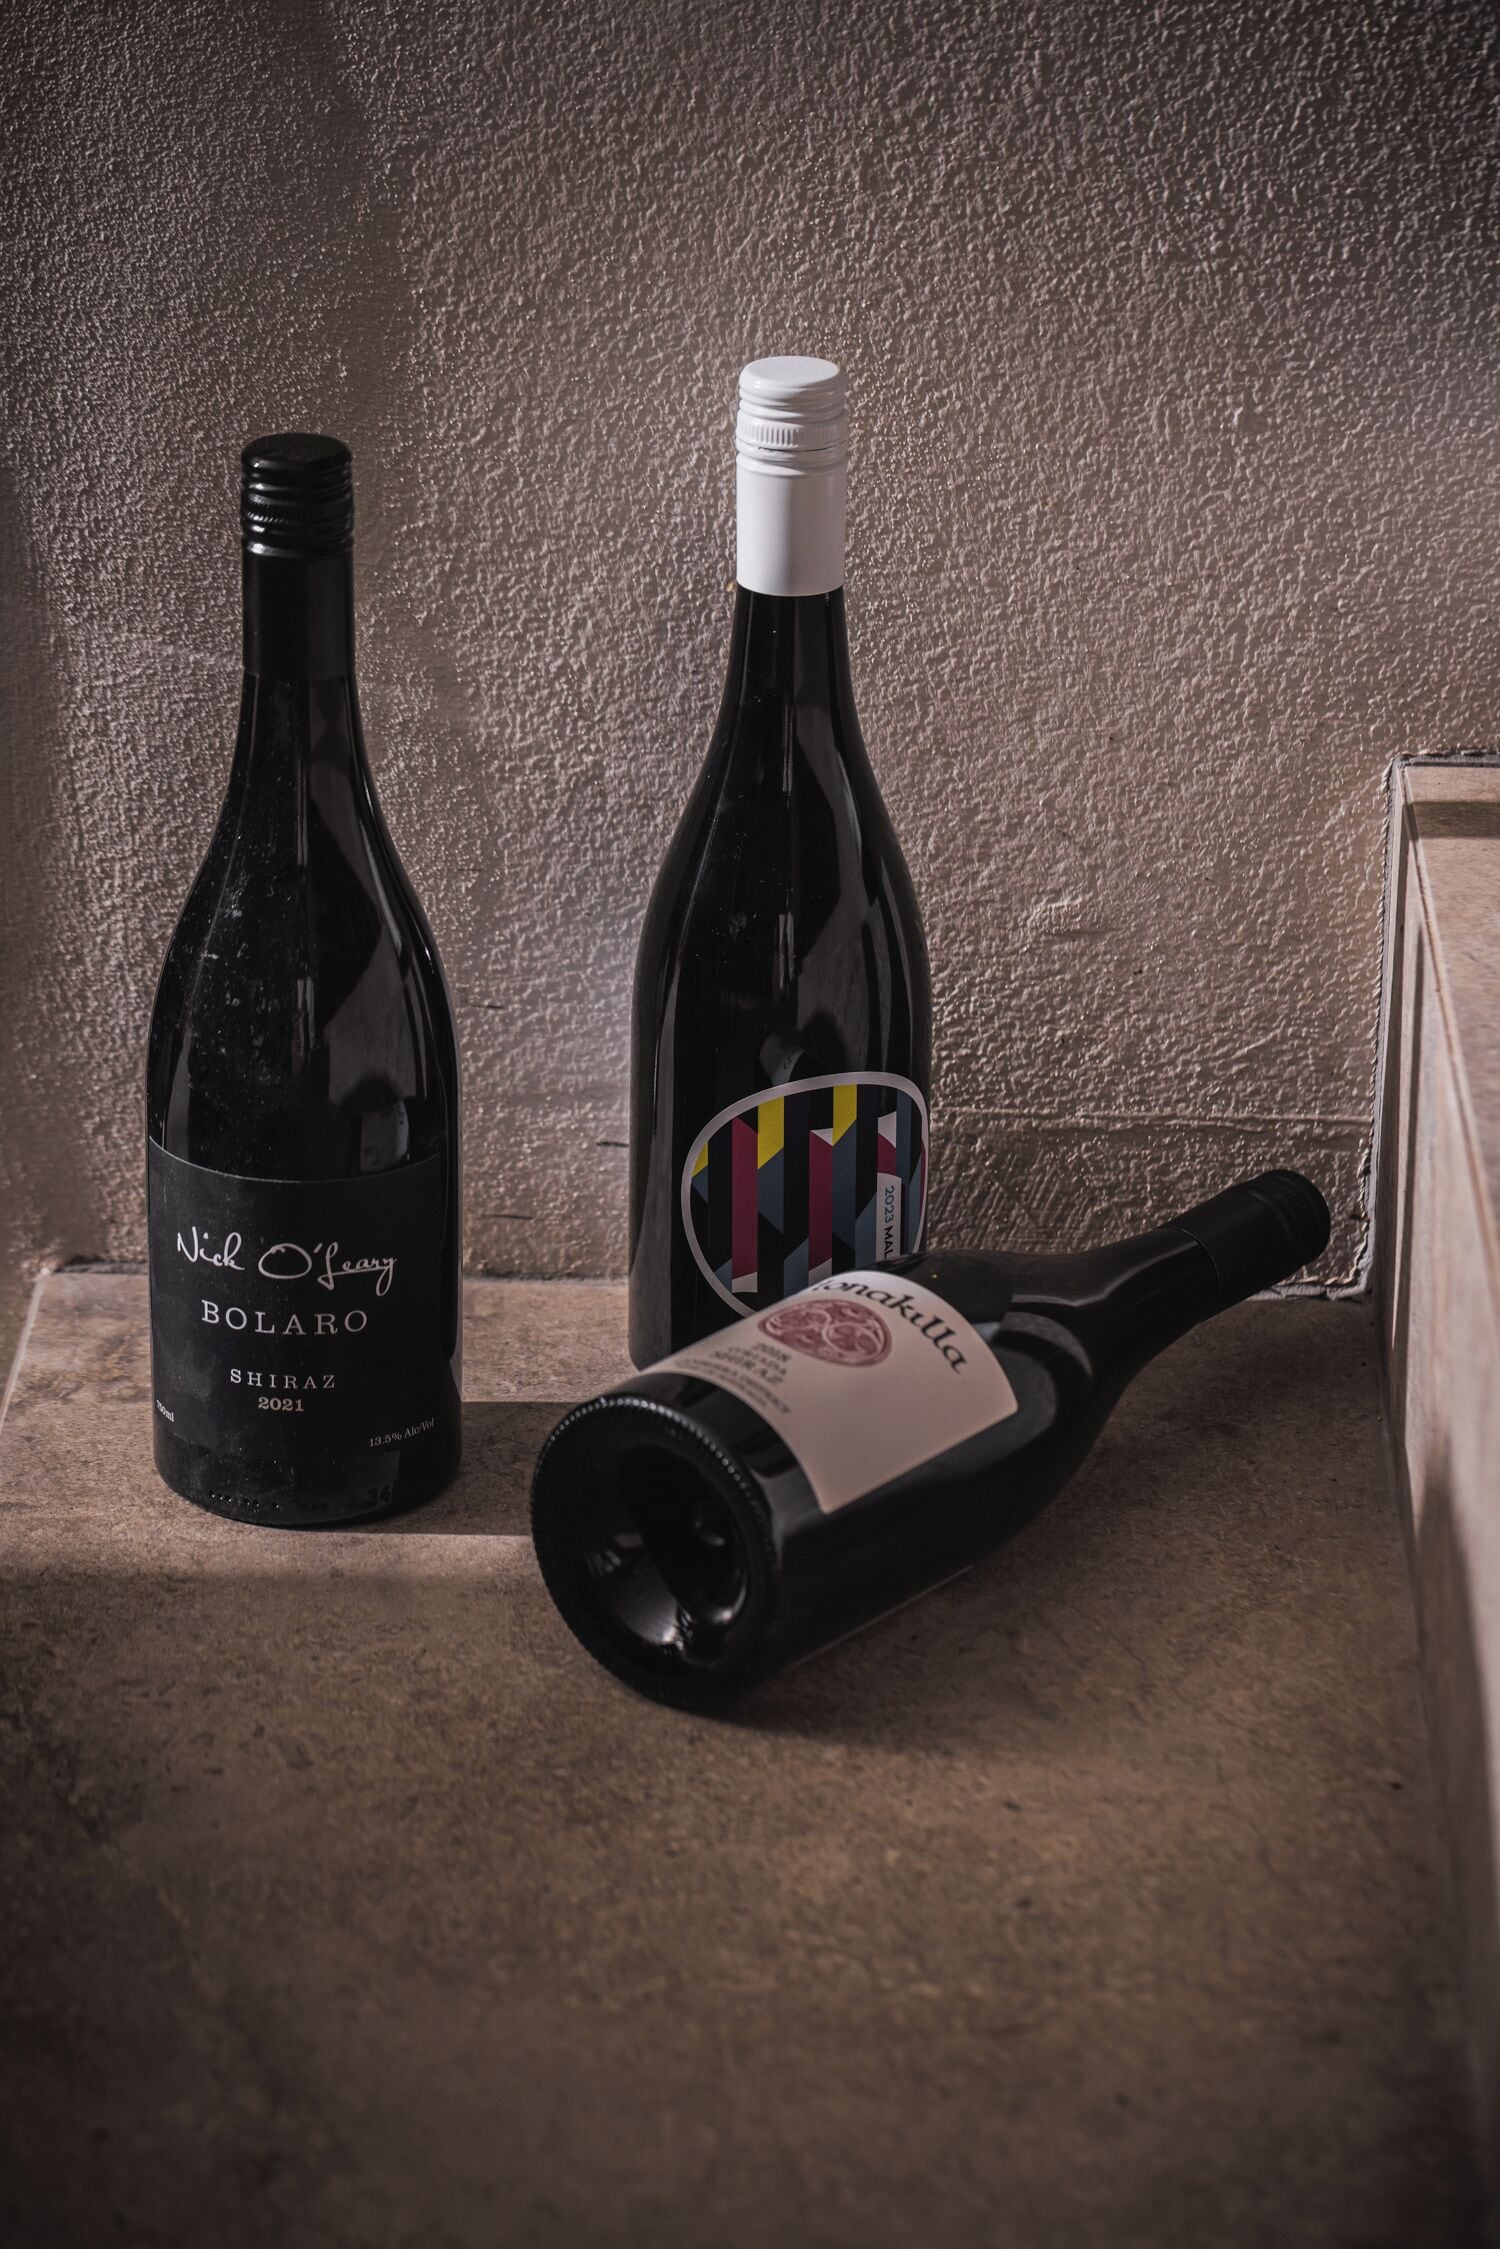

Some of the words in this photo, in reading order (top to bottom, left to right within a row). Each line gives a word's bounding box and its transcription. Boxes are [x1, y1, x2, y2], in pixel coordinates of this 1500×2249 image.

[884, 1185, 895, 1224] 2023
[883, 1225, 895, 1260] MAL
[176, 1226, 245, 1271] Nick
[258, 1241, 397, 1297] O'Leary
[201, 1299, 368, 1336] BOLARO
[230, 1368, 336, 1390] SHIRAZ
[258, 1396, 305, 1413] 2021
[368, 1432, 403, 1448] 13.5%
